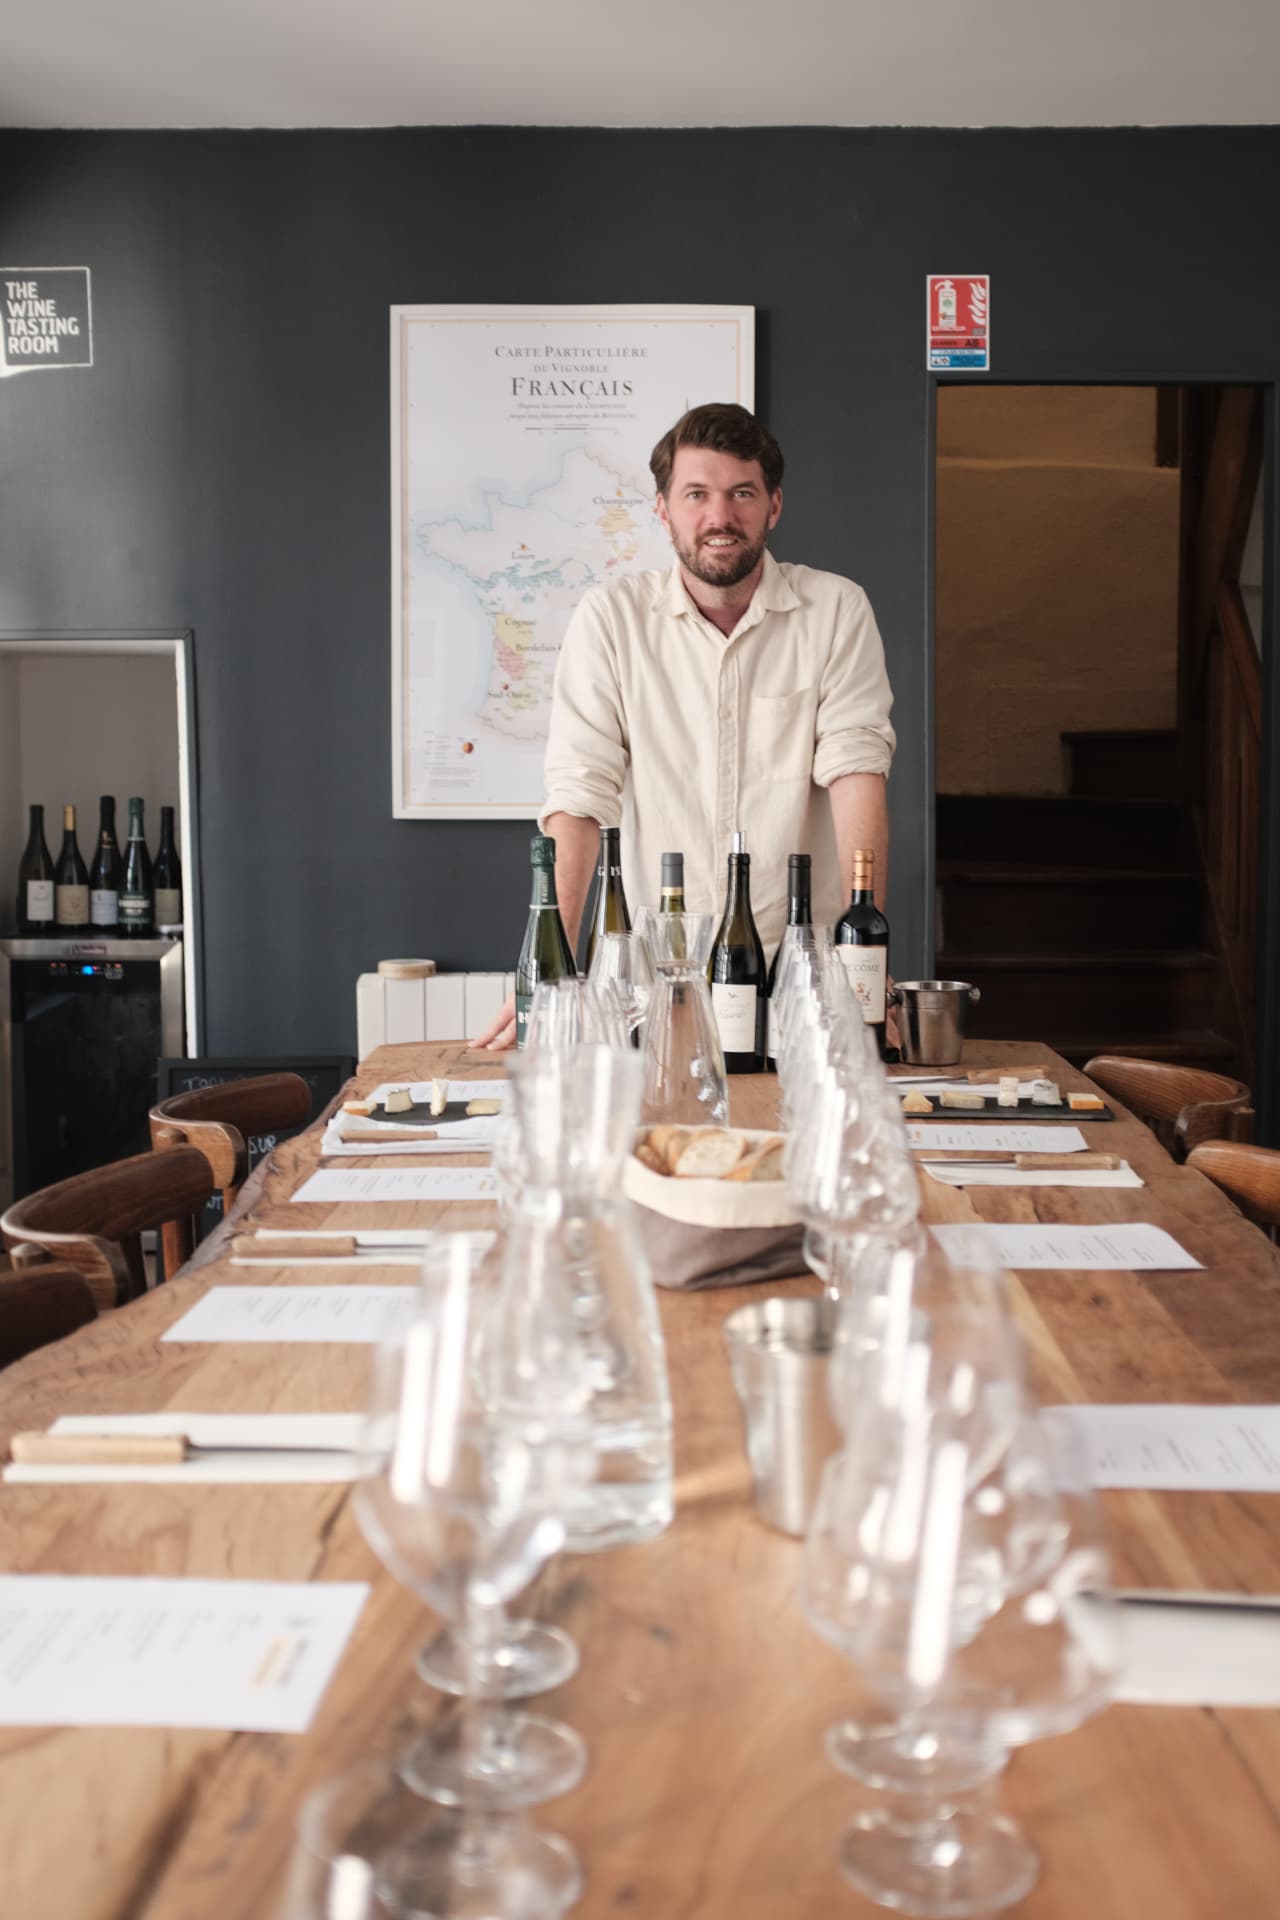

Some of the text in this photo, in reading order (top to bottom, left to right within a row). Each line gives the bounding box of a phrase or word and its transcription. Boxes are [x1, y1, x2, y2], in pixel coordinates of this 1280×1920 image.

[5, 281, 38, 299] THE
[7, 299, 56, 317] WINE
[8, 317, 79, 335] TASTING
[8, 336, 59, 354] ROOM
[495, 345, 539, 358] CARTE
[552, 362, 608, 373] VIGNOBLE
[511, 377, 633, 400] FRANÇAIS
[593, 496, 644, 507] Champagne
